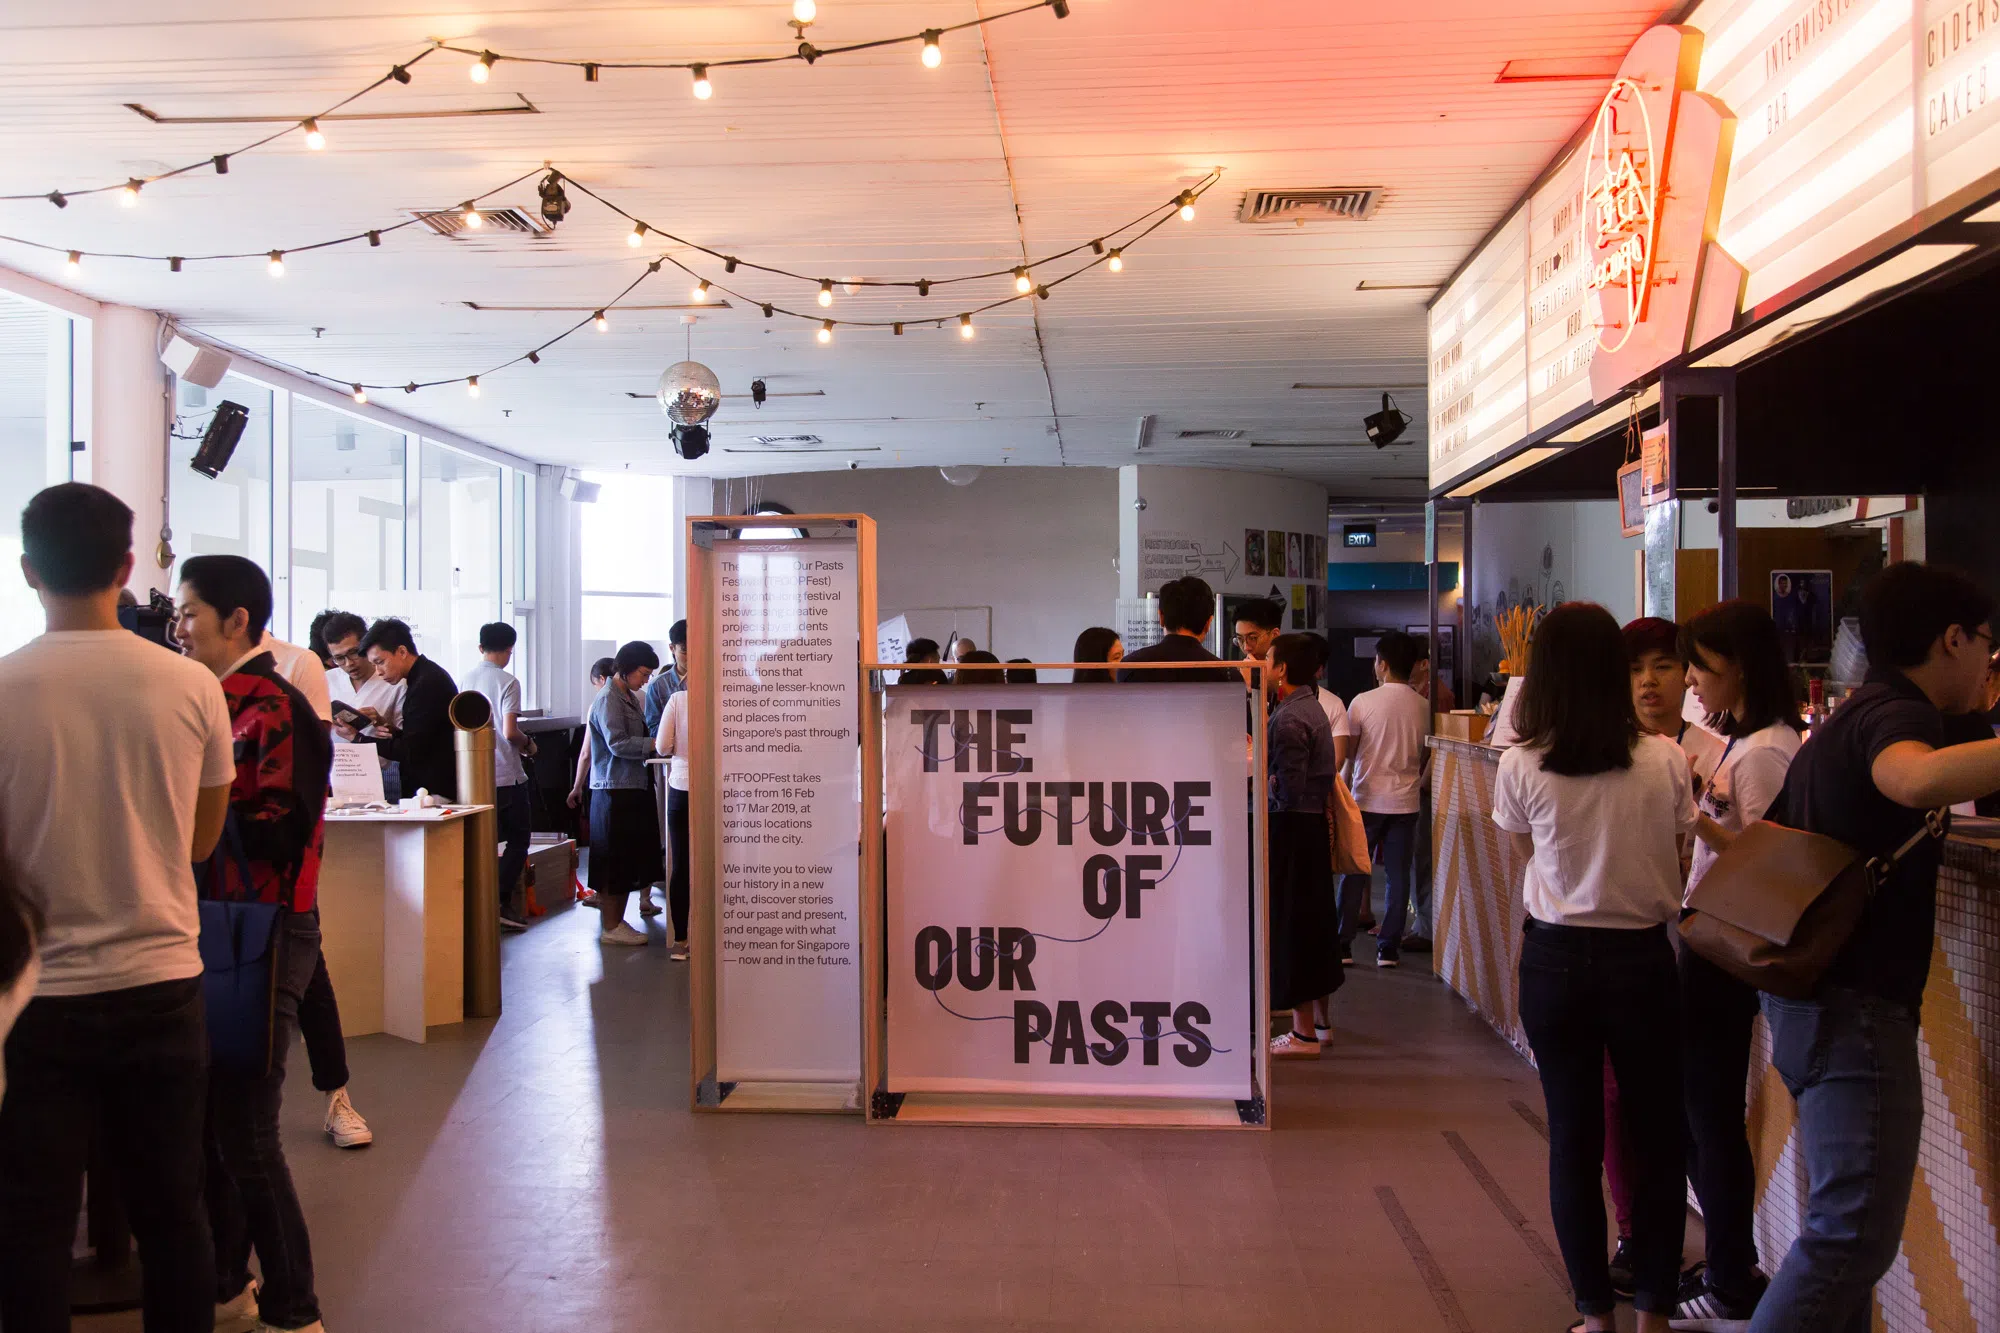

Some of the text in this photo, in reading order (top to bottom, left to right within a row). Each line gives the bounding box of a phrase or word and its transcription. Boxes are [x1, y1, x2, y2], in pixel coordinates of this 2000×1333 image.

[1766, 0, 1855, 79] INTERMISSI
[1349, 535, 1366, 545] EXIT
[815, 561, 844, 570] Pasts
[722, 592, 730, 601] is
[803, 590, 841, 601] festival
[722, 636, 832, 648] and recent graduates
[722, 652, 746, 662] from
[796, 652, 833, 663] tertiary
[723, 667, 803, 676] institutions that
[723, 682, 845, 693] reimagine lesser-known
[723, 698, 840, 707] stories of communities
[723, 713, 806, 724] and places from
[723, 728, 850, 739] Singapore's past through
[911, 710, 1033, 773] THE
[723, 743, 803, 752] arts and media.
[723, 773, 821, 782] #TFOOPFest takes
[723, 788, 814, 800] place from 16 Feb
[723, 804, 810, 814] to 17 Mar 2019, at
[963, 782, 1211, 846] FUTURE
[723, 819, 812, 828] various locations
[723, 834, 803, 846] around the city.
[723, 864, 832, 876] We invite you to view
[723, 879, 824, 891] our history in a new
[1082, 854, 1162, 919] OF
[724, 895, 833, 906] light, discover stories
[724, 910, 847, 921] of our past and present,
[724, 925, 836, 936] and engage with what
[723, 940, 747, 951] they
[780, 940, 794, 949] for
[797, 940, 849, 951] Singapore
[763, 956, 783, 964] and
[786, 956, 796, 964] in
[798, 956, 814, 964] the
[817, 956, 851, 965] future.
[914, 926, 1036, 991] OUR
[1014, 1000, 1212, 1068] PASTS
